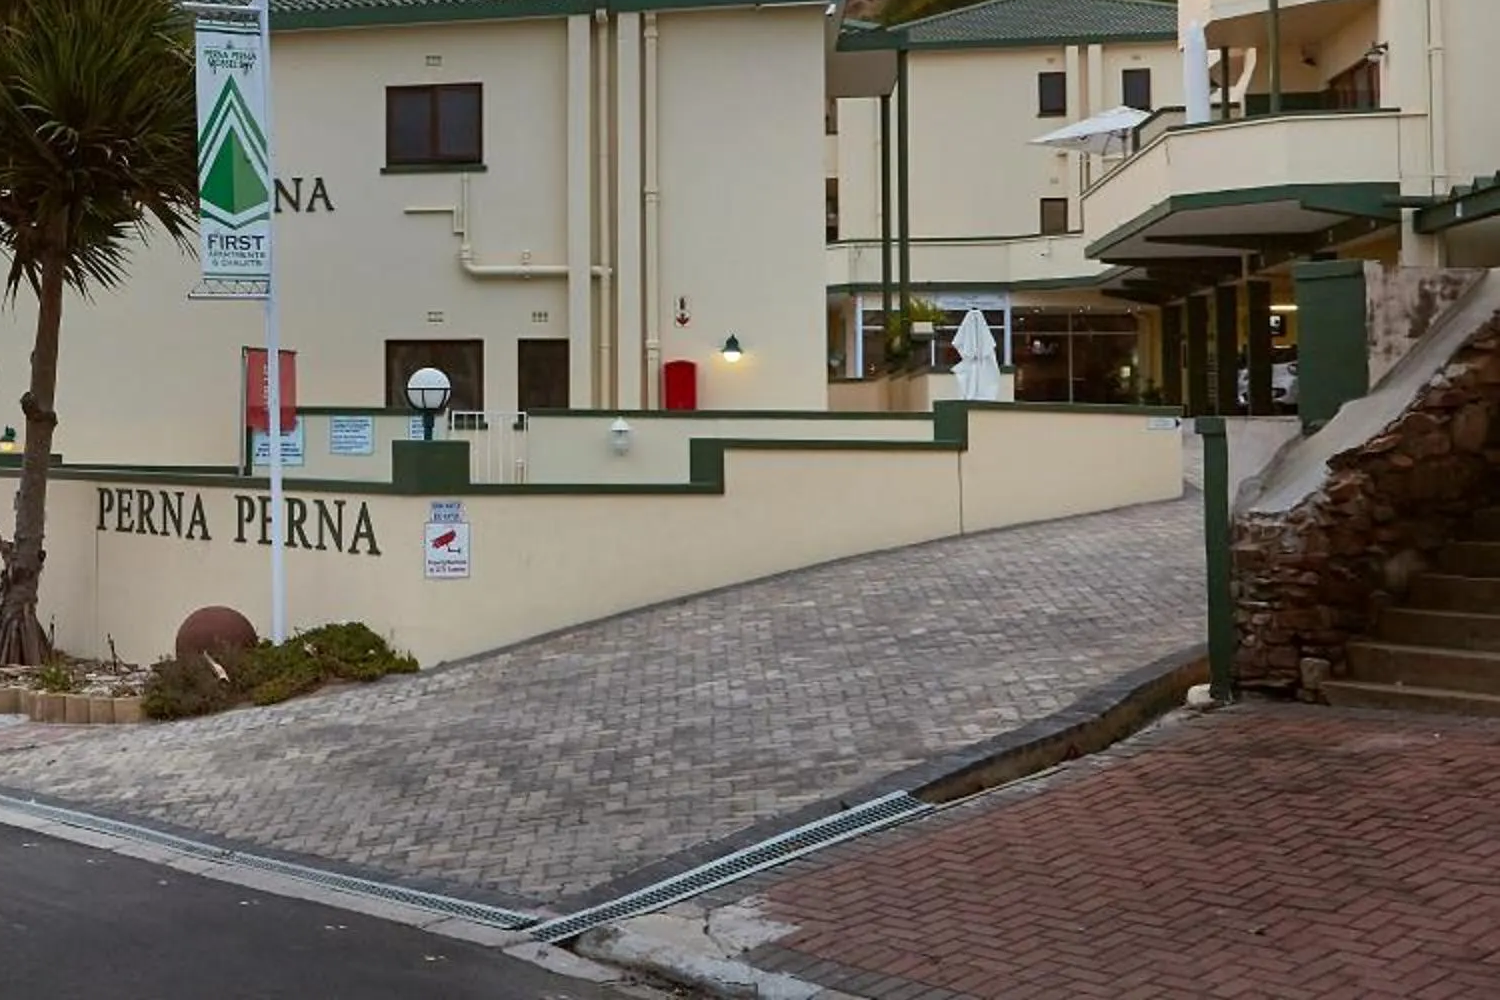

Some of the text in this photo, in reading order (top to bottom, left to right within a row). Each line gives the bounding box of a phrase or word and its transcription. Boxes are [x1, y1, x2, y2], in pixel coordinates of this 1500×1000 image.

[207, 233, 265, 250] FIRST
[96, 487, 382, 556] PERNA PERNA
